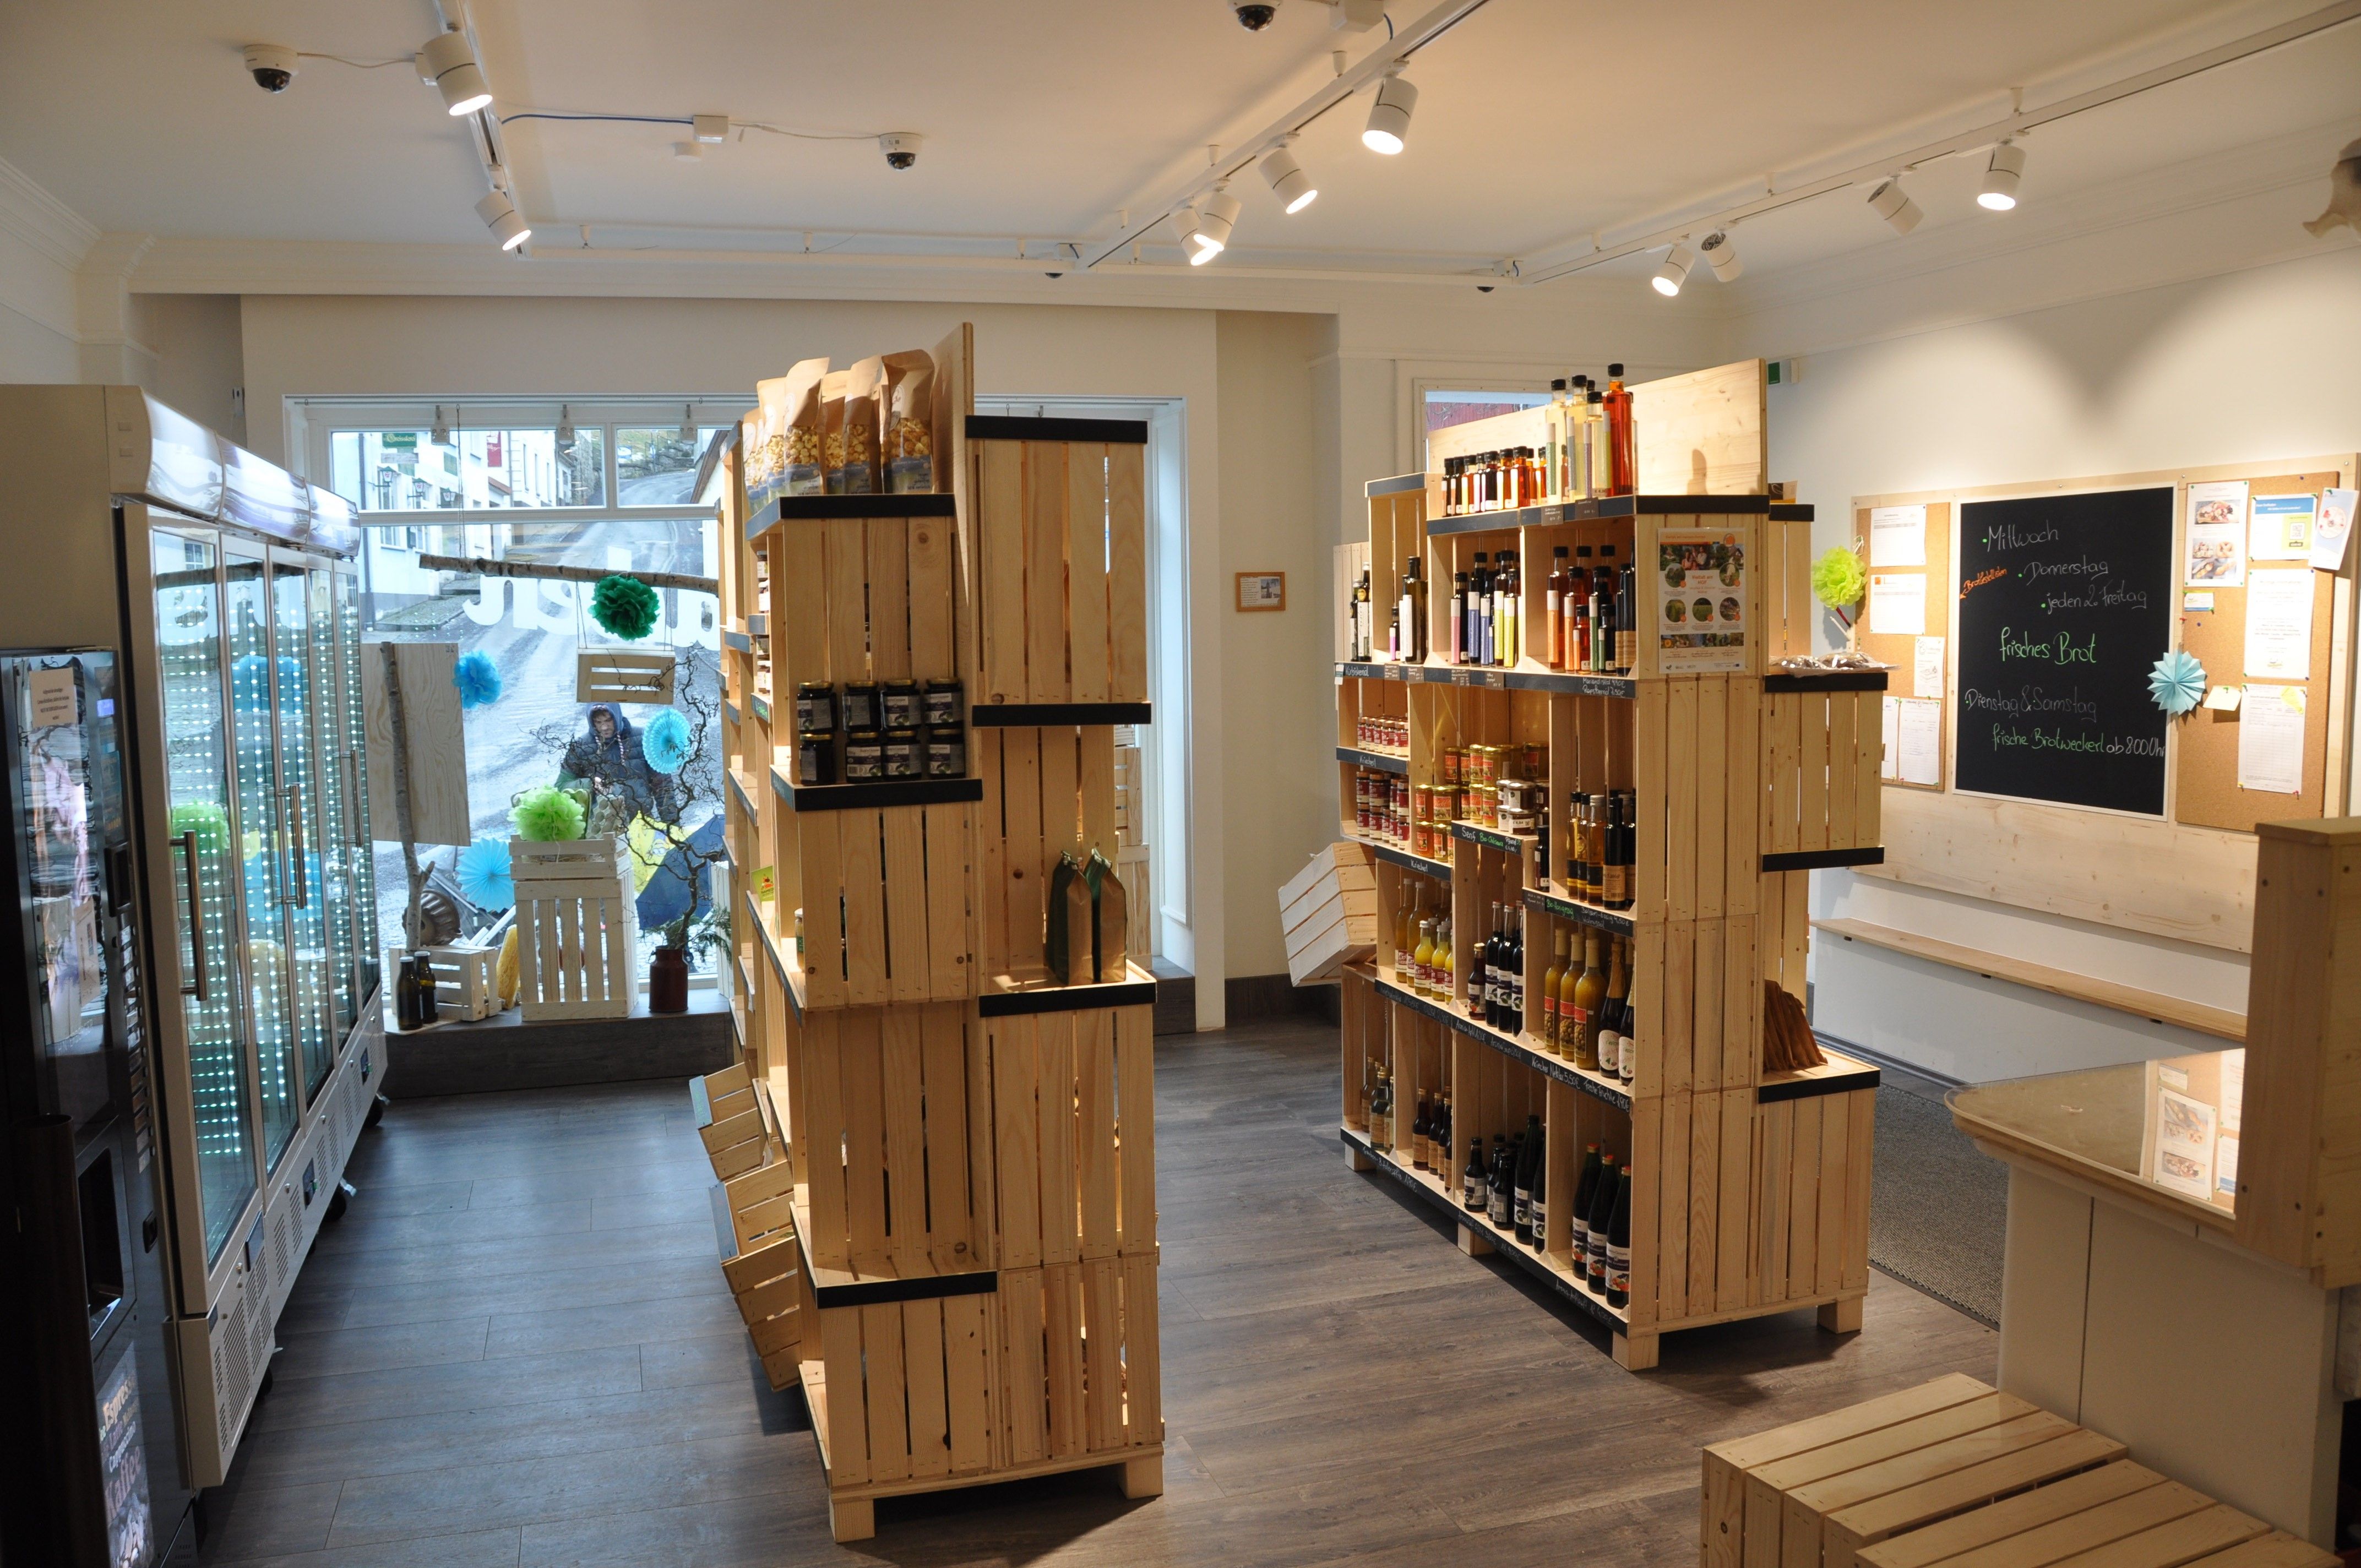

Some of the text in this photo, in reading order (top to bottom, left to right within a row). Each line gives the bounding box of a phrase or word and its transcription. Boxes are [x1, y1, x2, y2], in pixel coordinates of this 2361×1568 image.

[1987, 519, 2059, 552] Mittwoch
[2023, 554, 2109, 586] Donnerstag
[2046, 579, 2147, 615] jeden 2. Freitag
[1999, 627, 2097, 665] frisches Brot
[1965, 688, 2019, 718] Dienstag
[2033, 686, 2097, 723] Samstag
[1992, 722, 2028, 752] frische
[2031, 727, 2104, 753] Brotweckerl
[2106, 736, 2124, 755] ab
[1461, 826, 1476, 842] Senf
[105, 1445, 141, 1523] Kaffee
